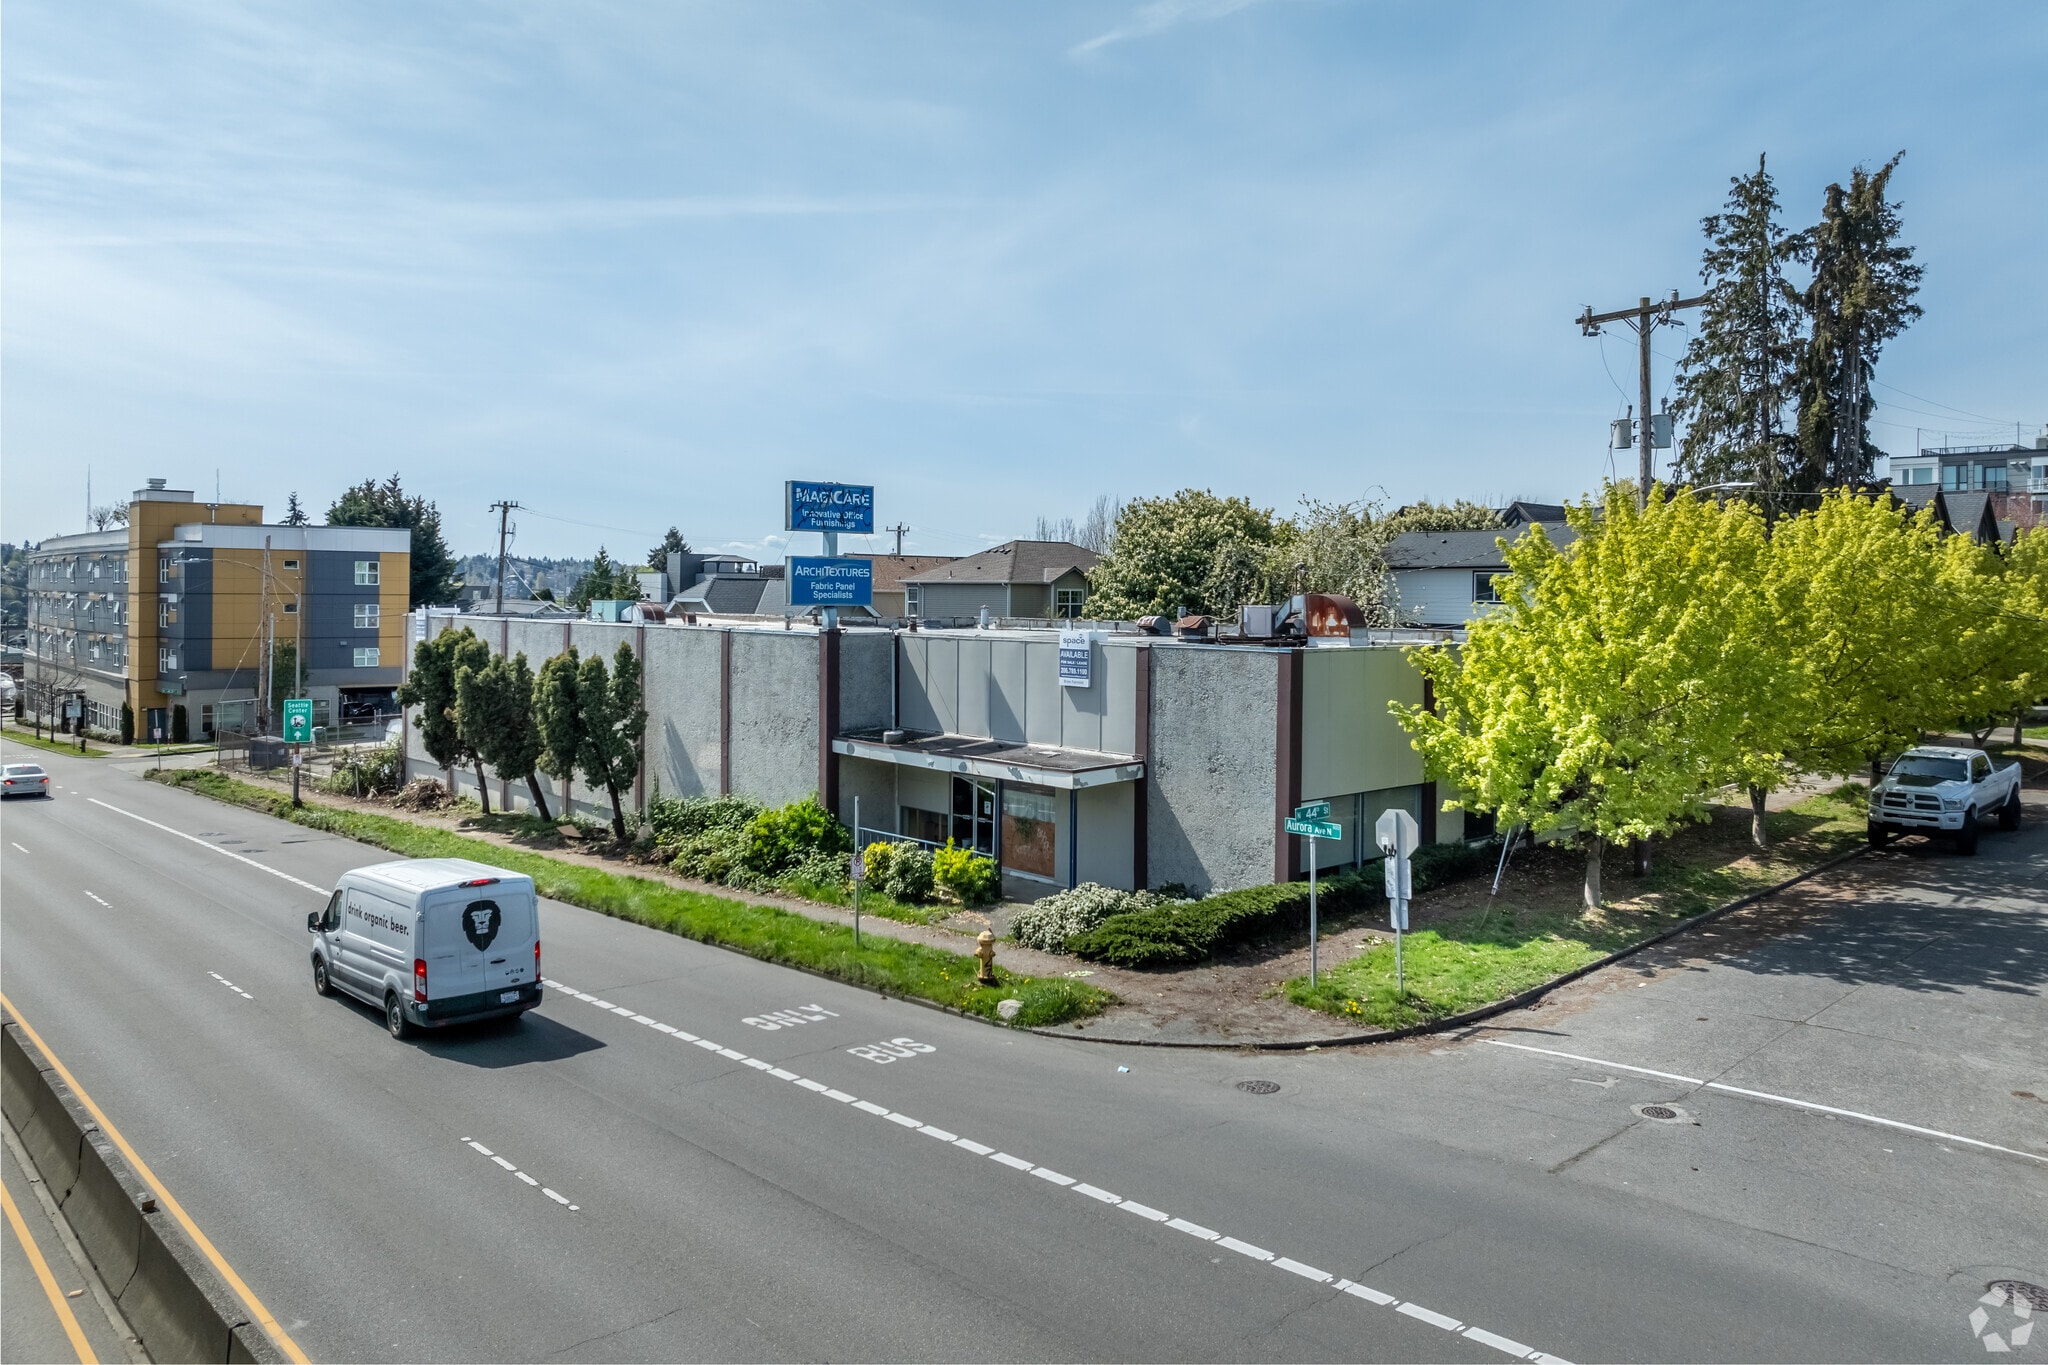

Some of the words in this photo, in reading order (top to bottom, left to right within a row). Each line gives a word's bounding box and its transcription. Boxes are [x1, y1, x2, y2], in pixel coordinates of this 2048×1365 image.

[810, 581, 834, 590] Fabric
[835, 582, 856, 591] Panel
[813, 590, 853, 601] Specialists
[1062, 637, 1086, 648] space
[1060, 650, 1088, 659] AVAILABLE
[1286, 819, 1313, 833] Aurora
[1314, 826, 1326, 835] Ave
[1326, 827, 1332, 836] N
[347, 901, 363, 919] drink
[363, 911, 388, 928] organic
[390, 916, 409, 936] beer.
[741, 1003, 841, 1031] ONLY
[846, 1037, 937, 1065] BUS
